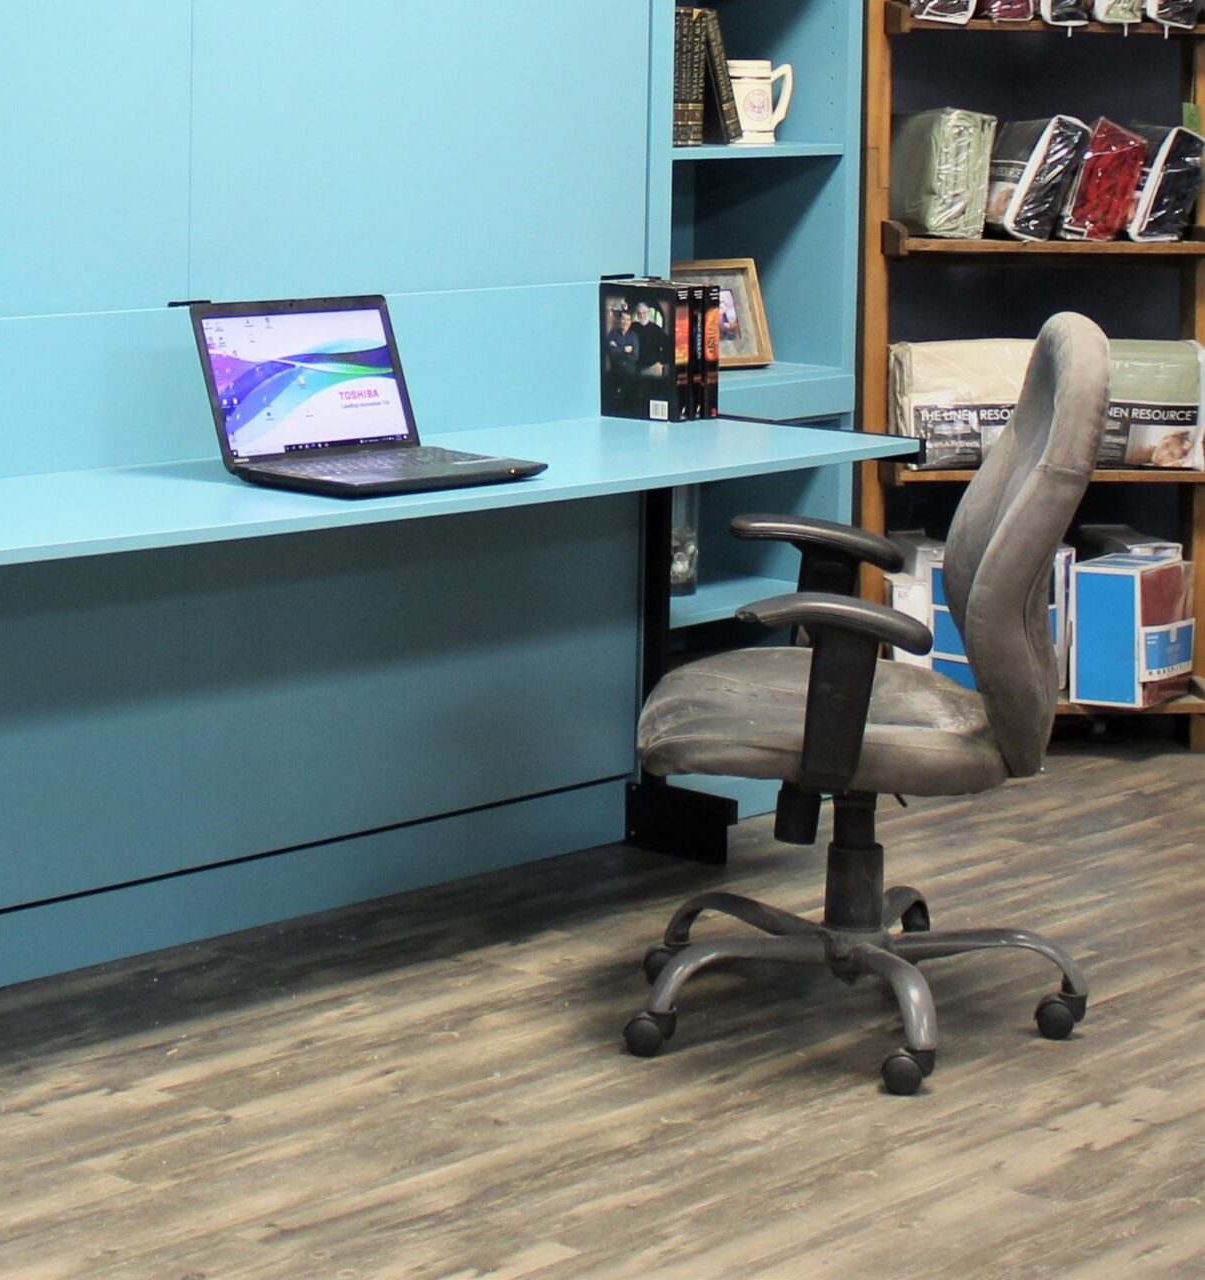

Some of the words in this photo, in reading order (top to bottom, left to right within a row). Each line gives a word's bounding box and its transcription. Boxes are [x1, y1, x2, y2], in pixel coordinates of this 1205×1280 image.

[338, 389, 380, 400] TOSHIBA
[920, 410, 941, 421] THE
[1131, 408, 1192, 421] RESOURCE
